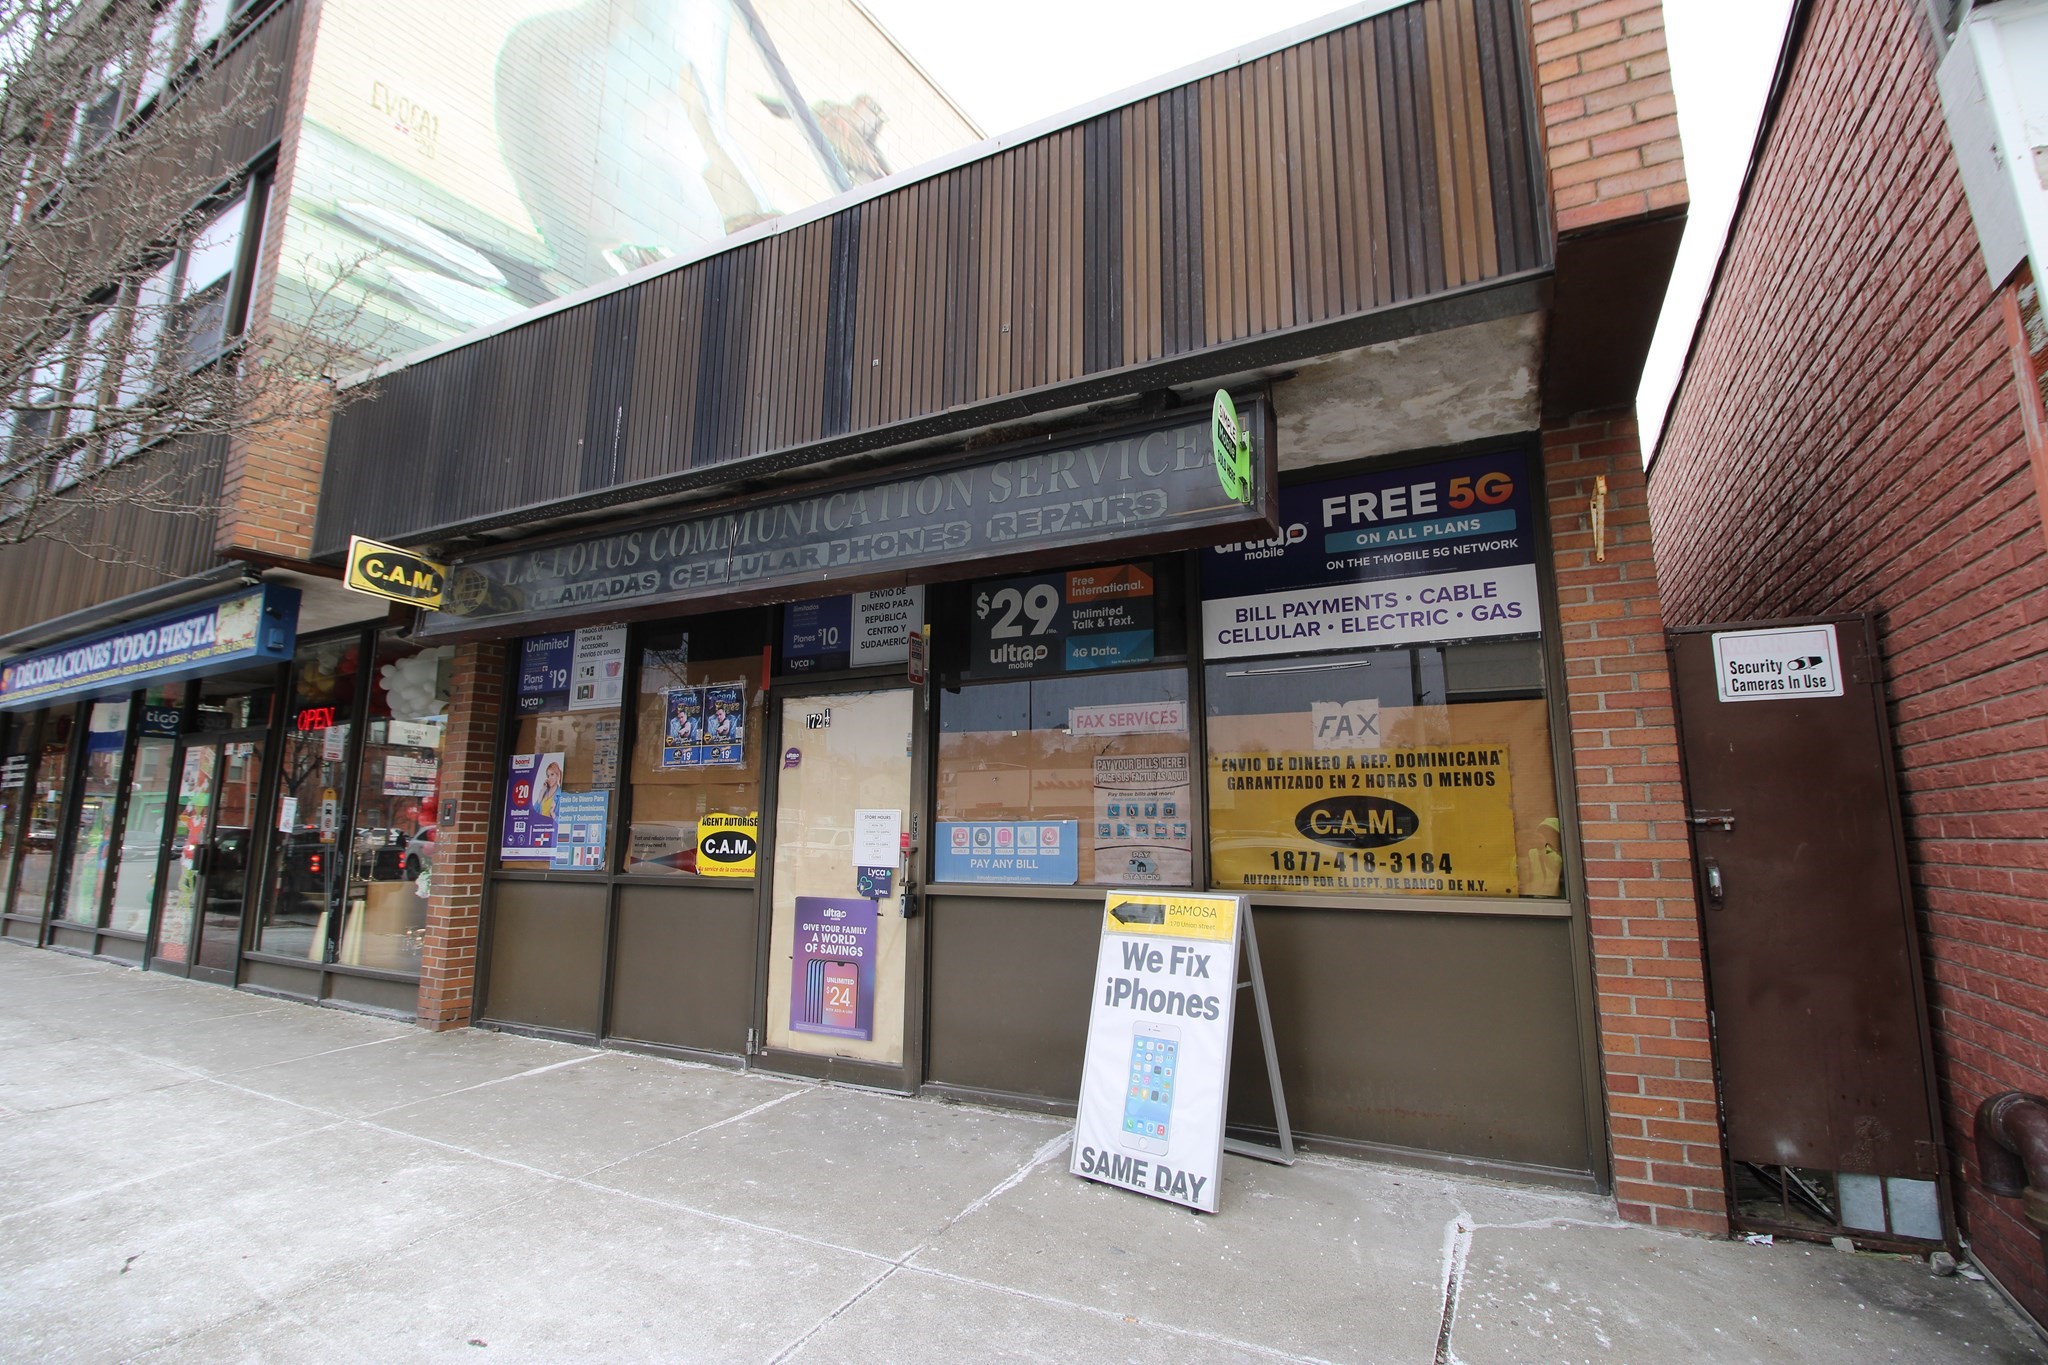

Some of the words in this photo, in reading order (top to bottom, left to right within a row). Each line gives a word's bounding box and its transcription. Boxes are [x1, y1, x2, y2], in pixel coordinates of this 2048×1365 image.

[1219, 404, 1237, 441] SIMPLE
[1322, 481, 1438, 528] FREE
[1448, 471, 1514, 510] 5G
[551, 531, 642, 578] LOTUS
[650, 468, 977, 562] COMMUNICATION
[672, 544, 824, 587] CELLULAR
[828, 521, 971, 566] PHONES
[989, 491, 1165, 541] REPAIRS
[1356, 532, 1381, 546] ON
[1387, 527, 1418, 542] ALL
[1423, 518, 1482, 537] PLANS
[1244, 546, 1285, 561] mobile
[1326, 560, 1345, 571] ON
[1346, 557, 1370, 568] THE
[1372, 549, 1430, 564] T-MOBILE
[1432, 546, 1450, 557] 5G
[1453, 538, 1519, 556] NETWORK
[365, 558, 439, 593] C.A.M.
[1072, 577, 1095, 587] Free
[895, 586, 907, 596] DE
[1072, 579, 1145, 597] International.
[861, 601, 891, 612] DINERO
[892, 598, 915, 608] PARA
[1235, 606, 1277, 623] BILL
[1282, 591, 1399, 618] PAYMENTS
[1419, 581, 1498, 604] CABLE
[1072, 605, 1123, 620] Unlimited
[867, 625, 899, 636] CENTRO
[901, 624, 907, 633] Y
[1072, 619, 1094, 630] Talk
[1097, 617, 1105, 628] &
[1108, 615, 1135, 627] Text.
[1217, 621, 1321, 645] CELLULAR
[1341, 608, 1449, 634] ELECTRIC
[1471, 601, 1523, 622] GAS
[793, 634, 816, 643] Planes
[817, 626, 839, 646] $10
[15, 641, 113, 689] DECORACIONES
[112, 629, 158, 665] TODO
[157, 613, 216, 656] FIESTA
[526, 636, 569, 653] Unlimited
[1072, 647, 1088, 658] 4G
[1091, 645, 1121, 657] Data.
[790, 659, 809, 670] Lyca
[1008, 660, 1034, 670] mobile
[1729, 659, 1783, 675] Security
[523, 674, 544, 684] Plans
[549, 668, 567, 689] $19
[1731, 678, 1785, 692] Cameras
[1788, 675, 1801, 689] In
[1804, 674, 1827, 688] Use
[521, 697, 538, 708] Lyca
[297, 706, 336, 731] OPEN
[806, 713, 823, 729] 172
[1077, 714, 1104, 729] FAX
[1109, 709, 1178, 727] SERVICES
[1318, 713, 1379, 738] FAX
[1096, 759, 1111, 771] PAY
[1112, 759, 1134, 771] YOUR
[1136, 757, 1159, 770] BILLS
[1161, 756, 1186, 769] HERE!
[1221, 757, 1261, 772] ENVIO
[1267, 756, 1284, 771] DE
[1288, 755, 1341, 771] DINERO
[1346, 755, 1356, 769] A
[1361, 754, 1392, 769] REP.
[1395, 750, 1501, 768] DOMINICANA
[1117, 772, 1130, 782] SUS
[1131, 771, 1166, 782] FACTURAS
[1226, 774, 1324, 790] GARANTIZADO
[1329, 774, 1346, 789] EN
[1351, 774, 1360, 789] 2
[1366, 772, 1417, 788] HORAS
[1439, 771, 1496, 787] MENOS
[515, 785, 529, 799] $20
[702, 817, 724, 826] AGENT
[724, 817, 758, 827] AUTORISE
[1310, 809, 1403, 835] C.A.M.
[705, 838, 752, 855] C.A.M.
[970, 859, 990, 869] PAY
[992, 859, 1013, 869] ANY
[1016, 859, 1039, 869] BILL
[1270, 850, 1453, 875] 1877-418-3184
[867, 867, 886, 877] Lyca
[1122, 873, 1160, 881] STATION
[1243, 874, 1310, 887] AUTORIZADO
[1313, 876, 1334, 888] POR
[1338, 877, 1349, 888] EL
[1352, 877, 1383, 889] DEPT.
[1386, 878, 1400, 889] DE
[1403, 878, 1444, 891] BANCO
[1448, 879, 1463, 891] DE
[1467, 880, 1488, 892] N.Y.
[823, 908, 841, 918] ultra
[1169, 904, 1218, 919] BAMOSA
[802, 923, 820, 932] GIVE
[820, 924, 840, 933] YOUR
[842, 925, 867, 935] FAMILY
[1198, 923, 1216, 931] street
[812, 933, 819, 943] A
[821, 934, 857, 945] WORLD
[805, 943, 818, 953] OF
[820, 943, 864, 957] SAVINGS
[1122, 941, 1164, 974] We
[1169, 945, 1212, 979] Fix
[826, 976, 855, 985] UNLIMITED
[826, 986, 850, 1007] $24
[1104, 977, 1220, 1021] iPhones
[1080, 1146, 1149, 1187] SAME
[1153, 1168, 1208, 1203] DAY
